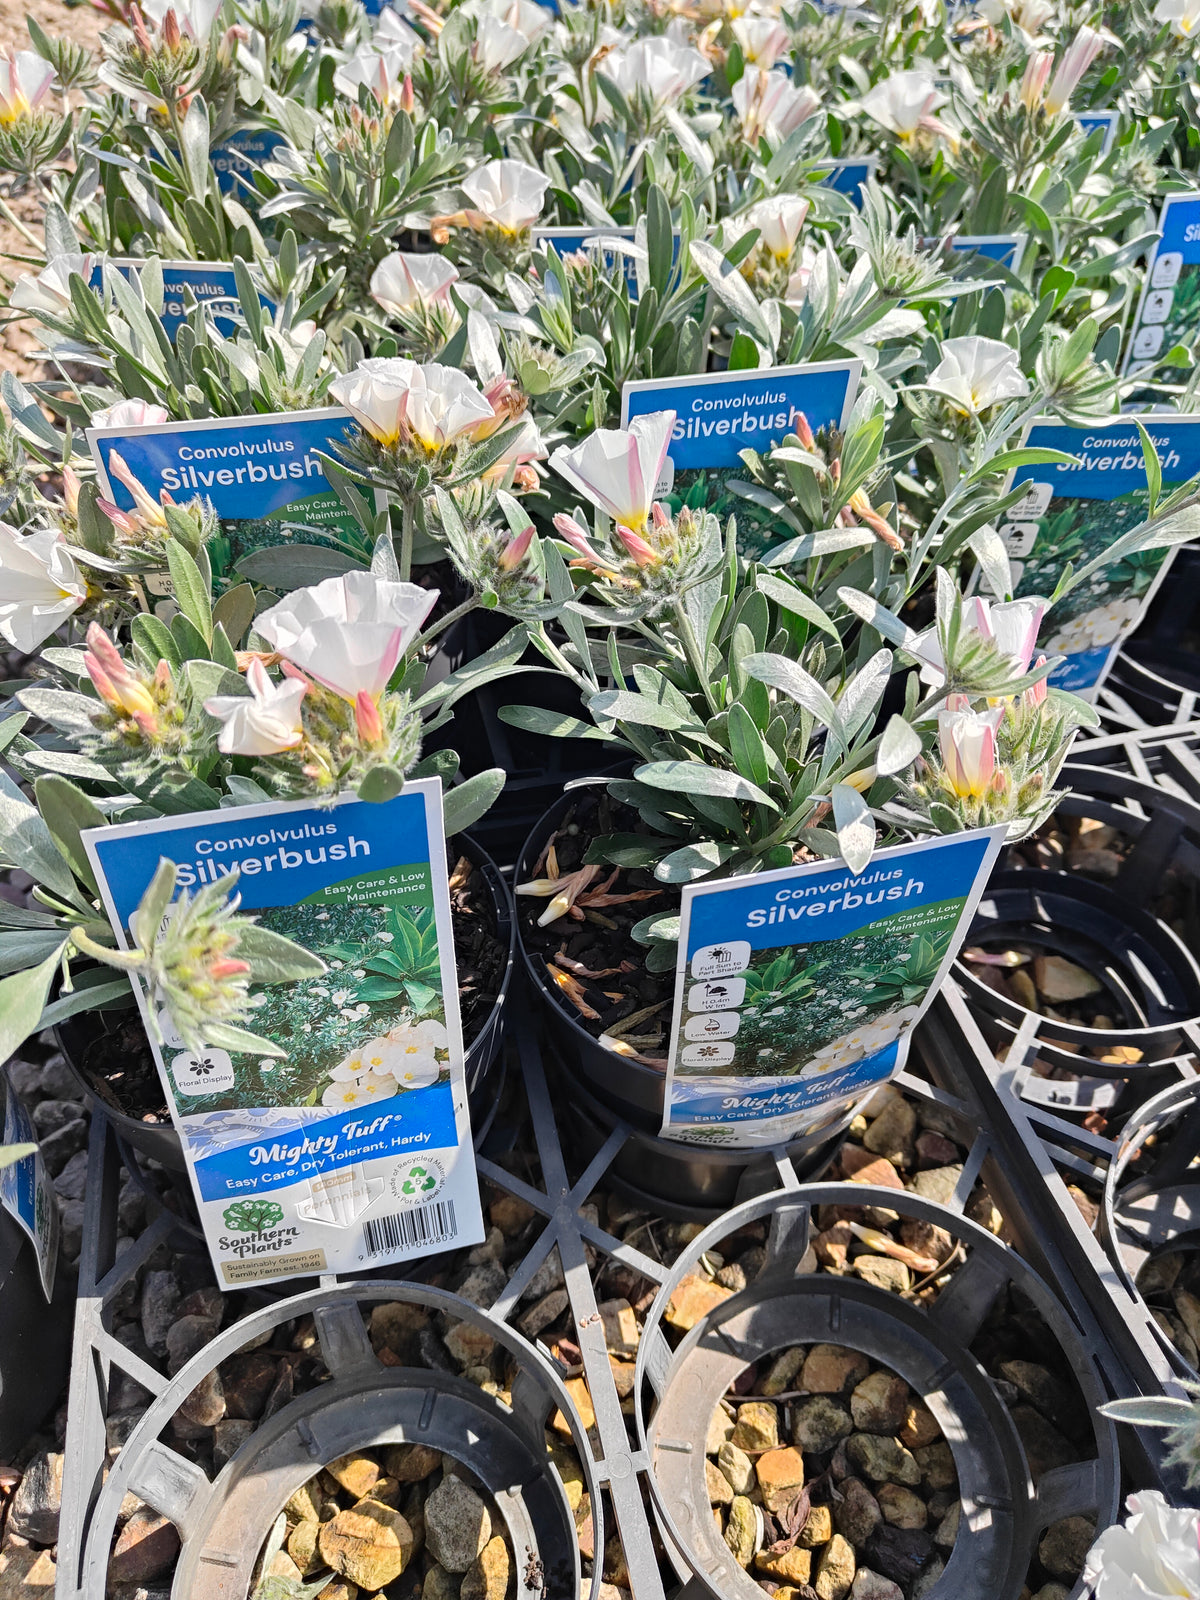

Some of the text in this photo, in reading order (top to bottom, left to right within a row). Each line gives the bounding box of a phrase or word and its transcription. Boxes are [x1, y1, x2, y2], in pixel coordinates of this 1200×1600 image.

[691, 390, 787, 413] Convolvulus
[178, 438, 295, 461] Convolvulus
[1082, 435, 1170, 449] Convolvlus
[160, 454, 324, 490] Silverbush
[286, 503, 311, 513] Easy
[312, 500, 337, 509] Care
[195, 823, 338, 855] Convolvulus
[324, 872, 426, 896] Easy Care & Low
[347, 882, 426, 903] Maintenance
[775, 869, 904, 902] Convolvulus
[746, 878, 925, 928] Silverbush
[868, 903, 961, 931] Easy Care & Low
[885, 912, 957, 934] Maintenance
[178, 1074, 233, 1089] Floral Display
[721, 1091, 803, 1111] Mighty
[694, 1113, 725, 1123] Easy
[762, 1105, 784, 1115] Dry
[226, 1132, 432, 1190] Easy Care, Dry Tolerant, Hardy
[249, 1133, 339, 1166] Mighty
[397, 1155, 434, 1169] Recycled
[218, 1226, 301, 1251] Southern
[226, 1252, 321, 1272] Sustainably Grown on
[230, 1269, 258, 1280] Family
[301, 1260, 321, 1268] 1946
